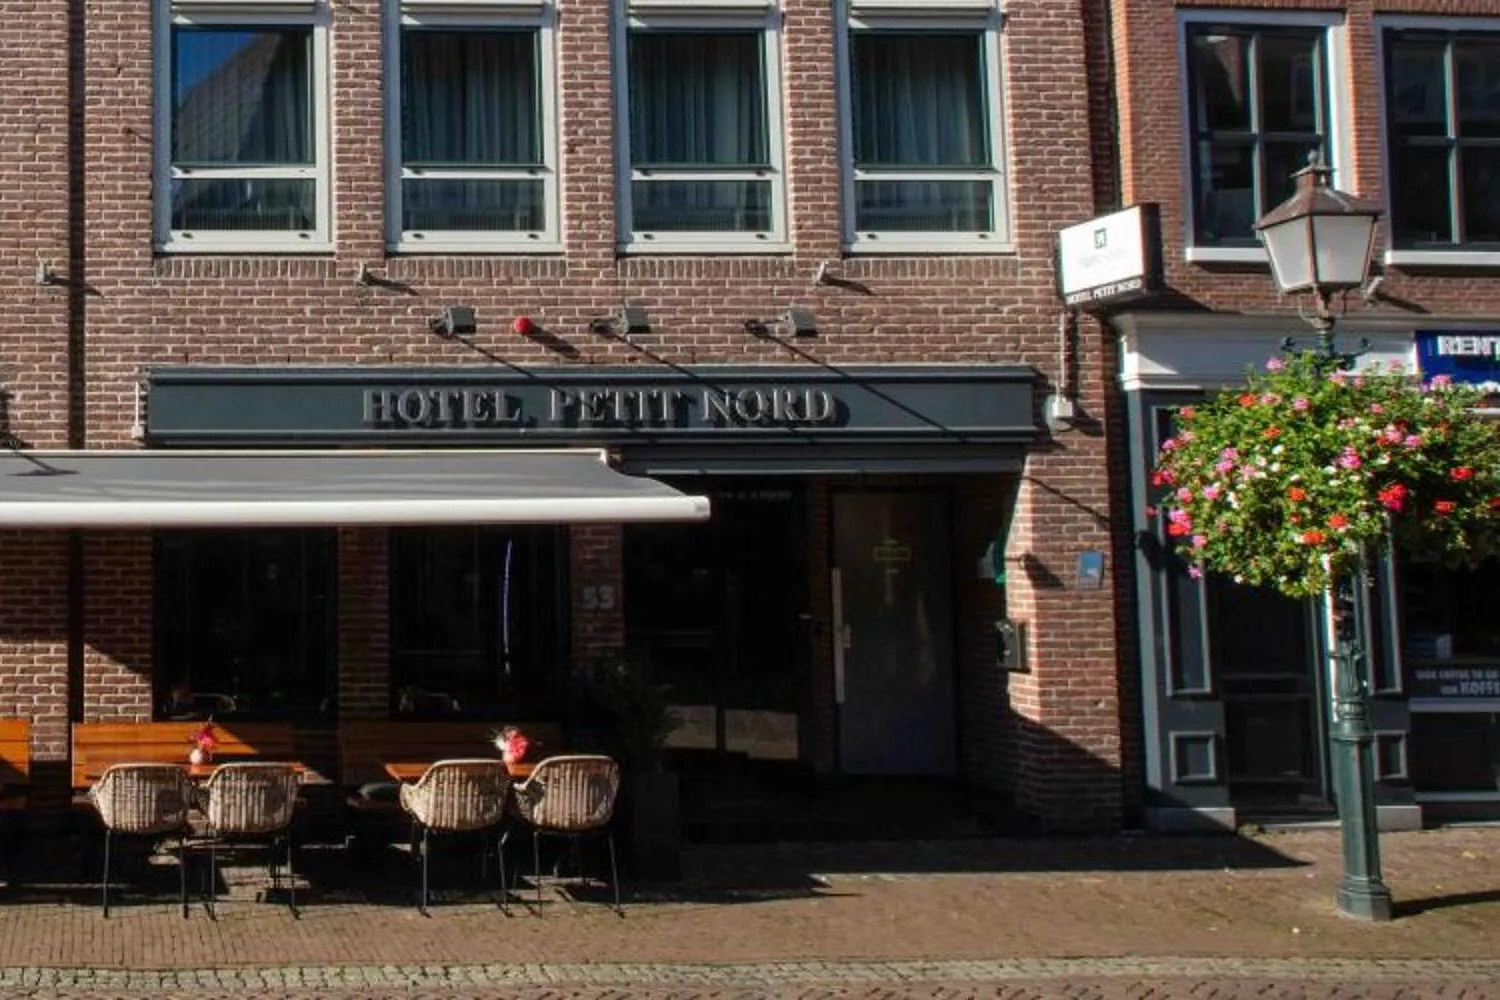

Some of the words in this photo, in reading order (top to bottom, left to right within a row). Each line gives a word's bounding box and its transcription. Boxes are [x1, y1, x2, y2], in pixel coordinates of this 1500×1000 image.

[362, 388, 521, 423] HOTEL
[547, 387, 682, 422] PETIT
[702, 387, 835, 422] NORD
